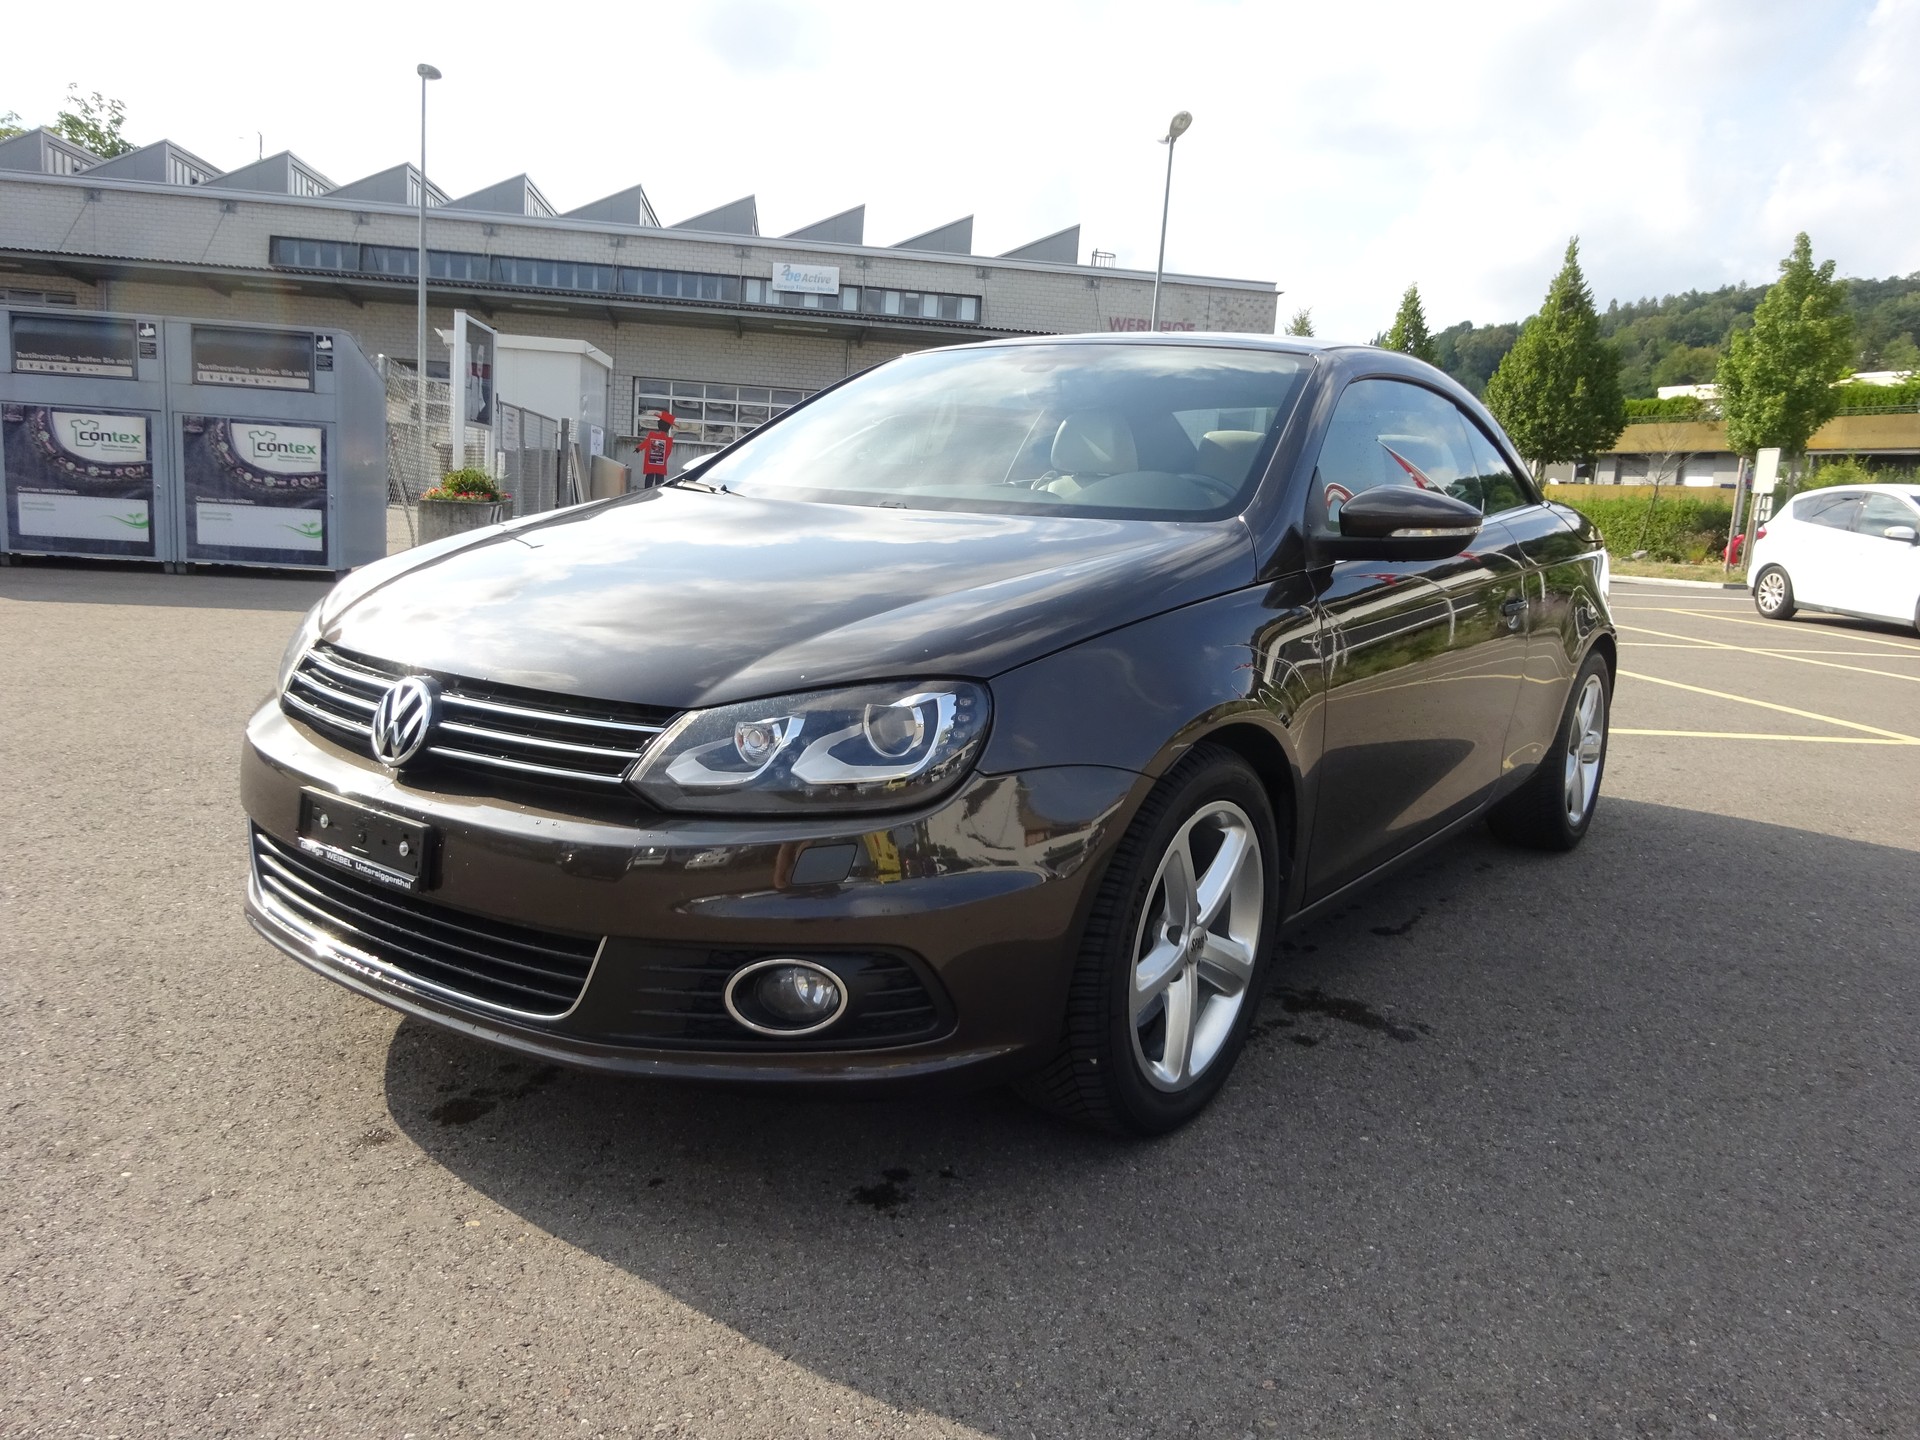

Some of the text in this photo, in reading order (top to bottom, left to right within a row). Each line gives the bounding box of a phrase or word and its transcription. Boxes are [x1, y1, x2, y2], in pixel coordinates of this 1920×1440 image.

[802, 272, 832, 284] Active
[16, 351, 71, 362] Textilrecycling
[78, 355, 101, 363] helfen
[103, 356, 115, 364] Sie
[116, 358, 132, 366] mit!
[197, 362, 250, 374] Textilrecycling
[256, 367, 280, 375] helfen
[79, 431, 141, 444] contex
[257, 441, 316, 455] contex
[326, 850, 353, 867] WEIBEL
[355, 862, 411, 889] Untersiggenthal
